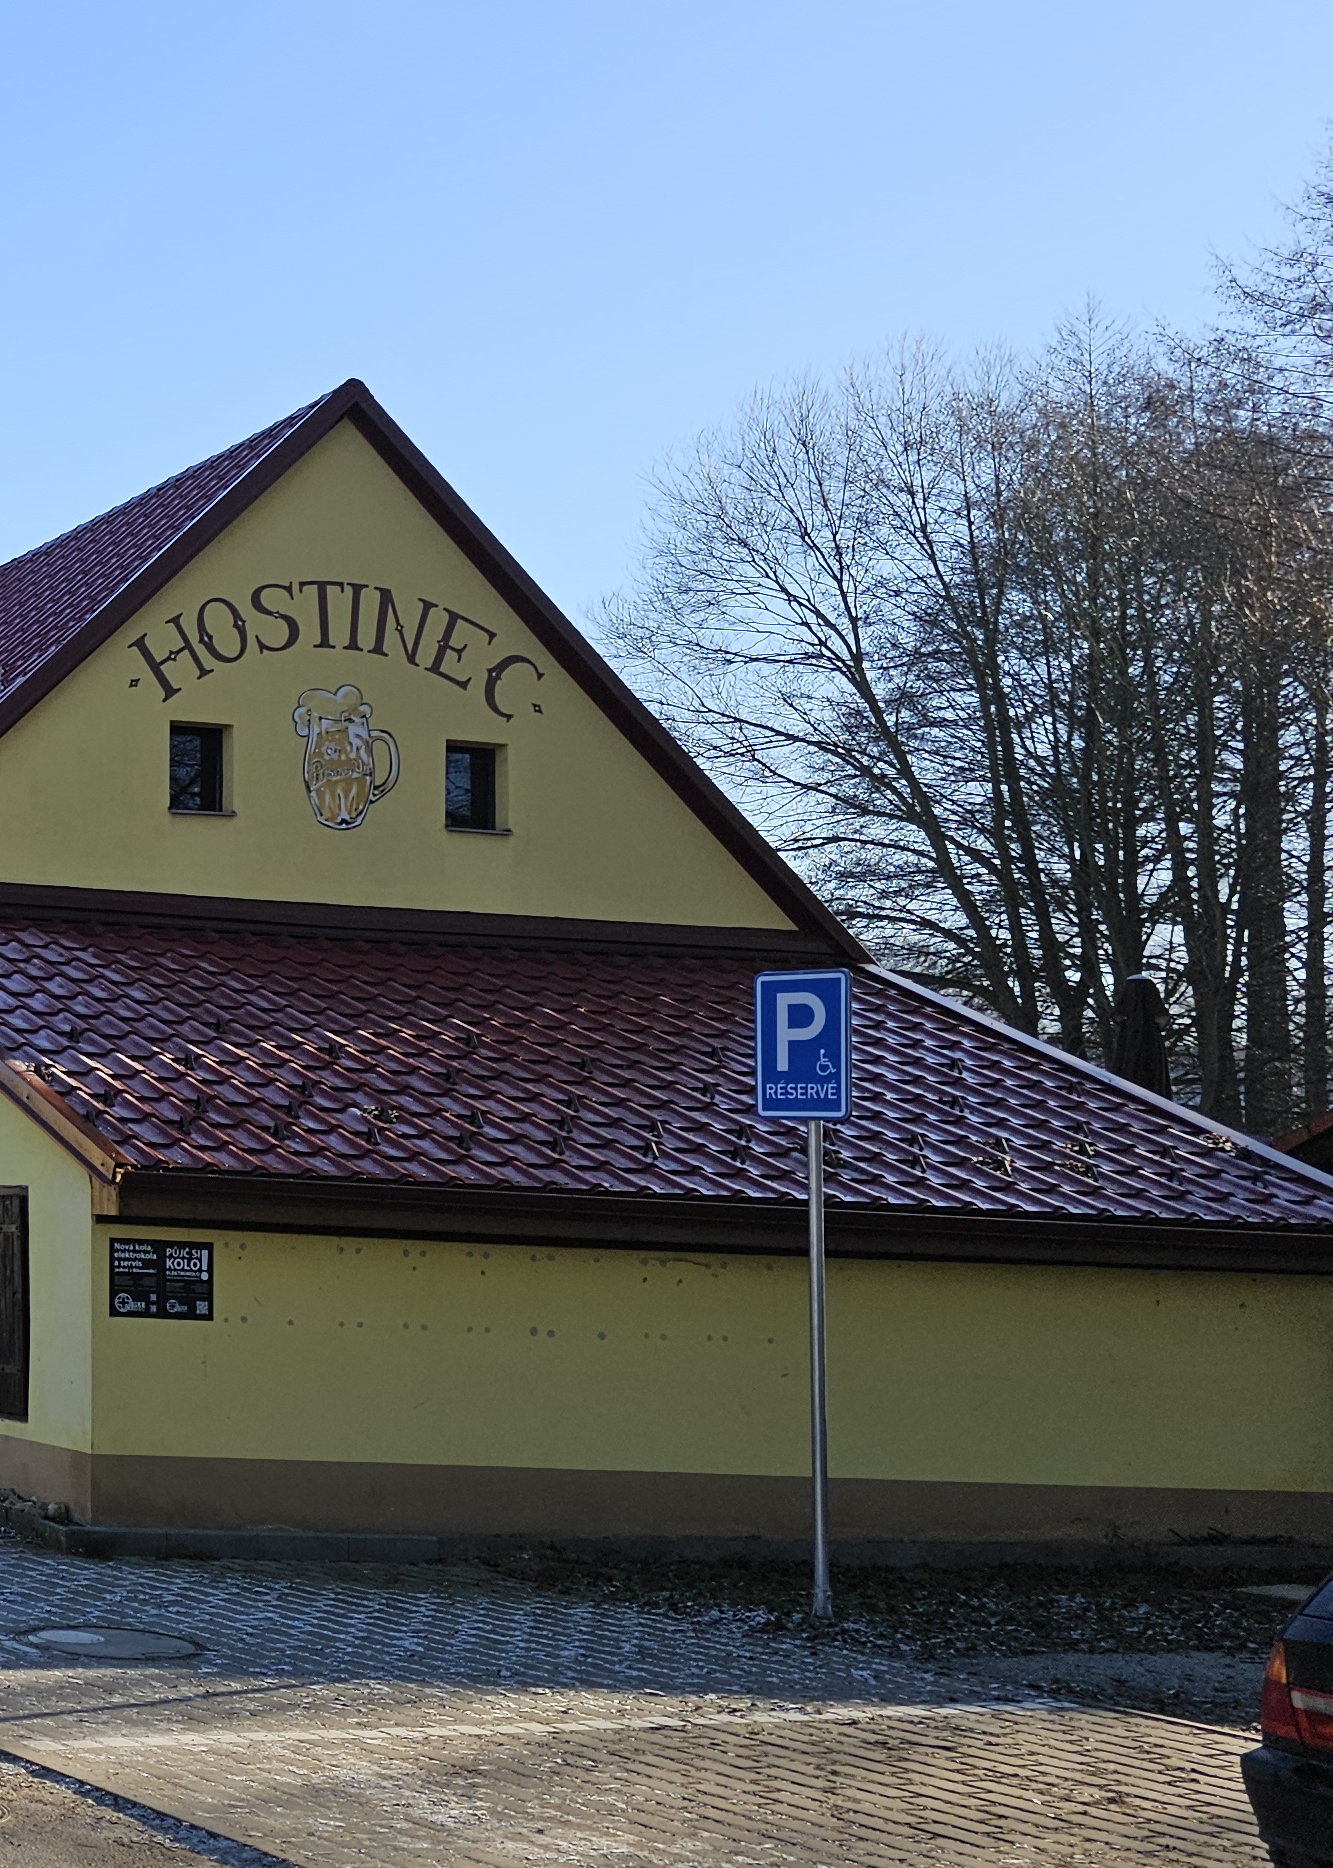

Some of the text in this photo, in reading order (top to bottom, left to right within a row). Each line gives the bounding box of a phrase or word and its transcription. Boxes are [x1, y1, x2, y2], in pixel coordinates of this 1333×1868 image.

[128, 580, 546, 723] HOSTINEC
[776, 991, 826, 1072] P
[766, 1080, 838, 1099] RÉSERVÉ
[114, 1242, 134, 1250] Nová
[166, 1246, 201, 1259] PŮJČ SI
[114, 1251, 157, 1260] elektrokola
[120, 1259, 143, 1267] servis
